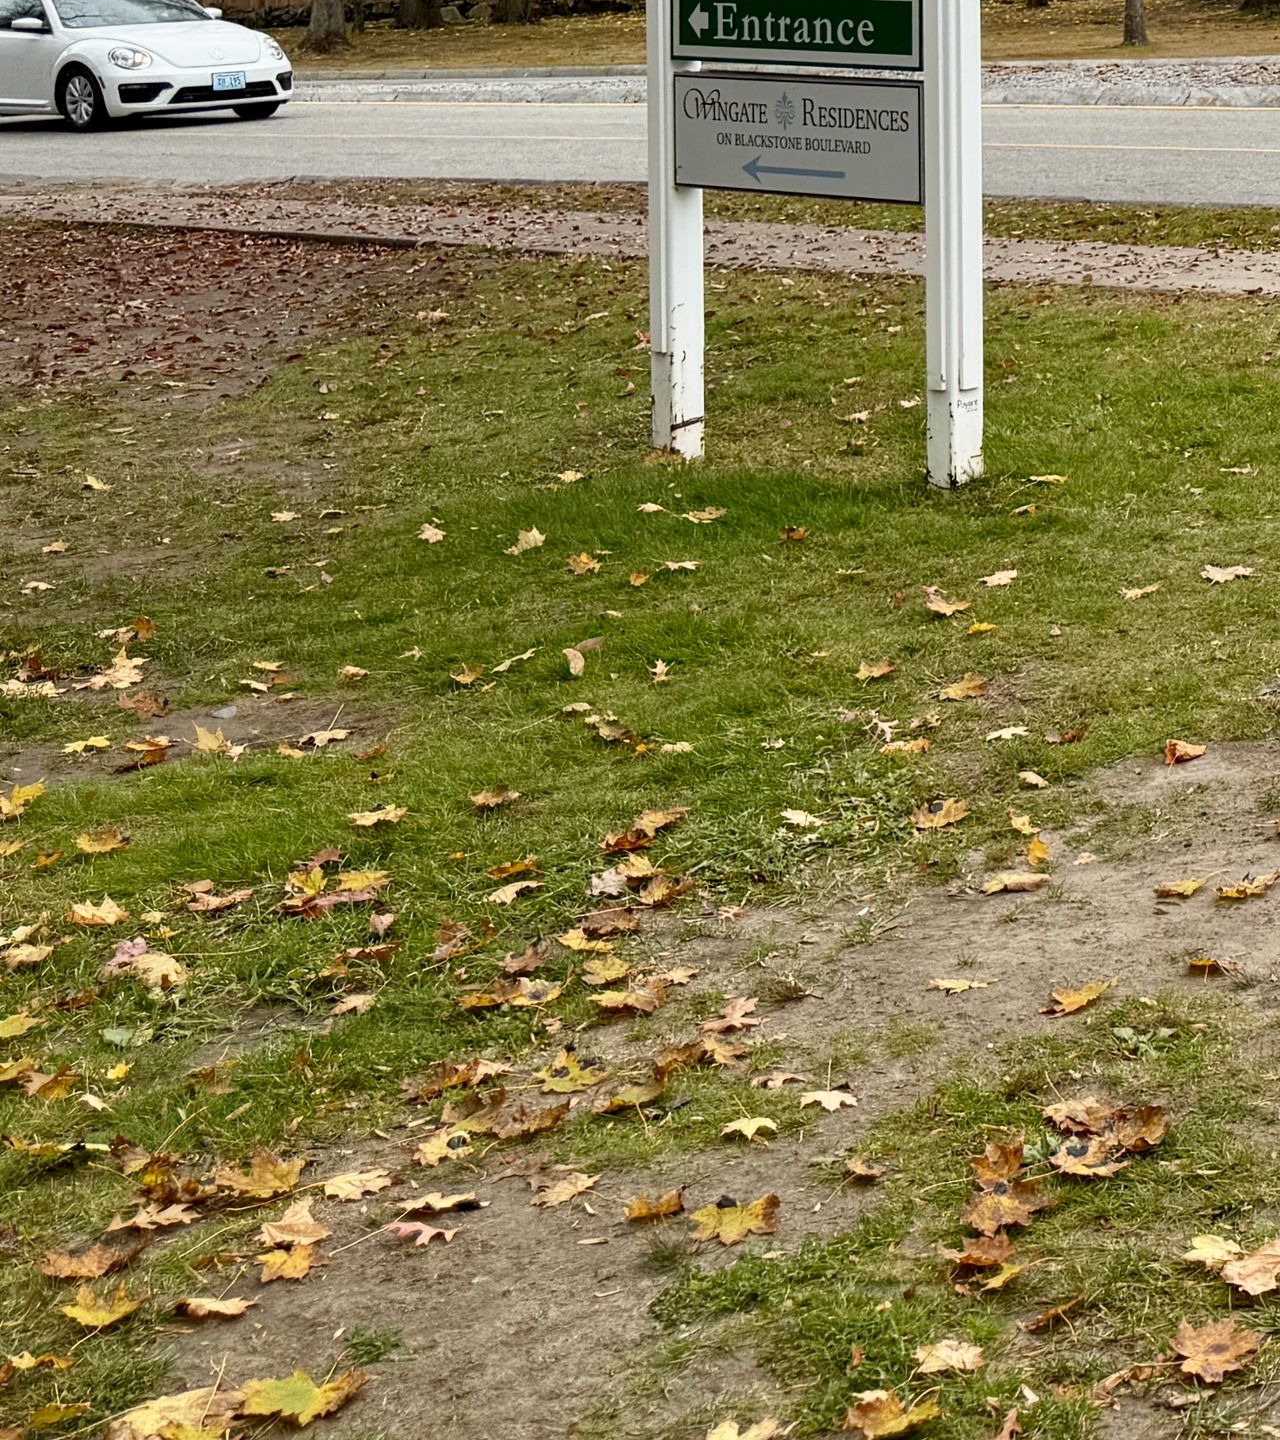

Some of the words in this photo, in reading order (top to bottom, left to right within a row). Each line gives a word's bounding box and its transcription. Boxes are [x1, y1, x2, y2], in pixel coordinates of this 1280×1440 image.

[713, 2, 875, 46] Entrance
[683, 88, 768, 124] WINGATE
[802, 98, 909, 132] RESIDENCES
[716, 132, 732, 145] ON
[734, 133, 802, 151] BLACKSTONE
[805, 138, 871, 155] BOULEVARD
